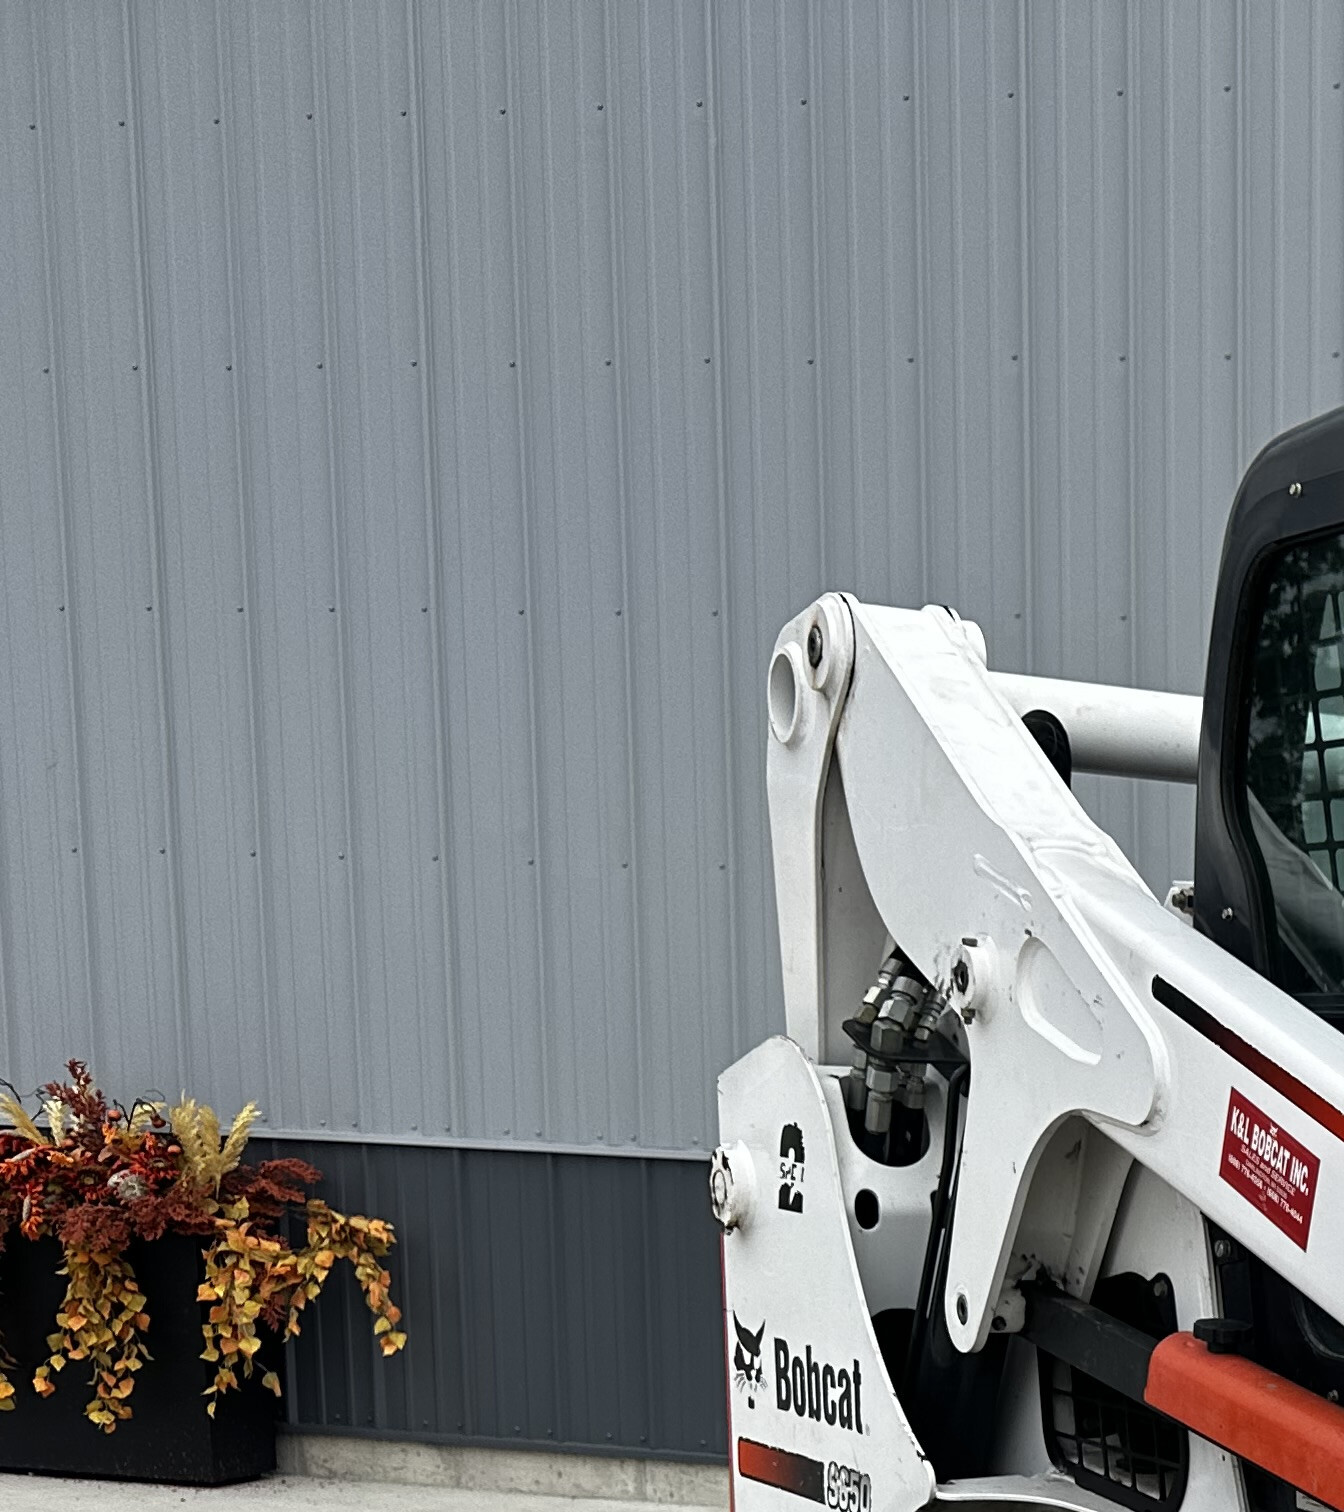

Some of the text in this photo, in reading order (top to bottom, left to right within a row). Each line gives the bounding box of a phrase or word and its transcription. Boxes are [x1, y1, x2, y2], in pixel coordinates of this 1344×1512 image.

[1230, 1106, 1249, 1145] K&L
[1251, 1124, 1290, 1176] BOBCAT
[1289, 1156, 1309, 1196] INC.
[1241, 1144, 1260, 1165] SALES
[1270, 1169, 1296, 1196] SERVICE
[774, 1337, 863, 1434] Bobcat
